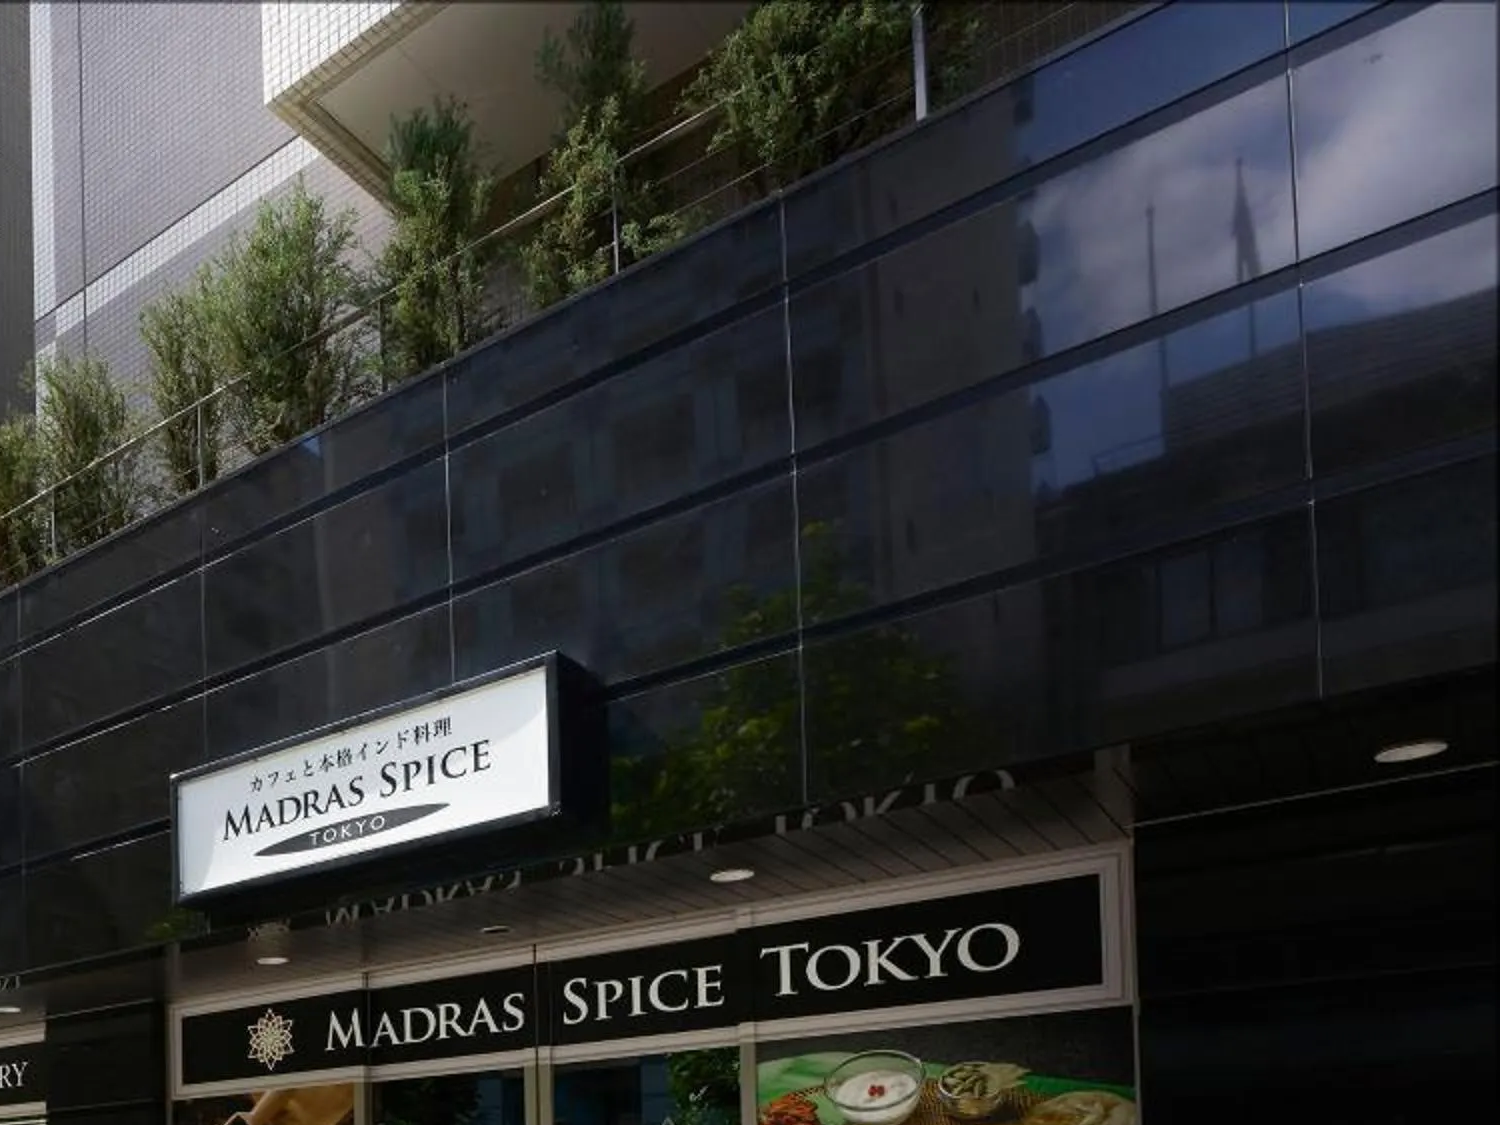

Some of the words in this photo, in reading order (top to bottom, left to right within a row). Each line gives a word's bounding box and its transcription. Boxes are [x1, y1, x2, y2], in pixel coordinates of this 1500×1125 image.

[223, 775, 365, 841] MADRAS
[380, 739, 491, 798] SPICE
[251, 717, 452, 792] カフェと本格インド料理
[309, 815, 386, 845] TOKYO
[325, 991, 524, 1052] MADRAS
[562, 964, 725, 1026] SPICE
[759, 921, 1021, 998] TOKYO
